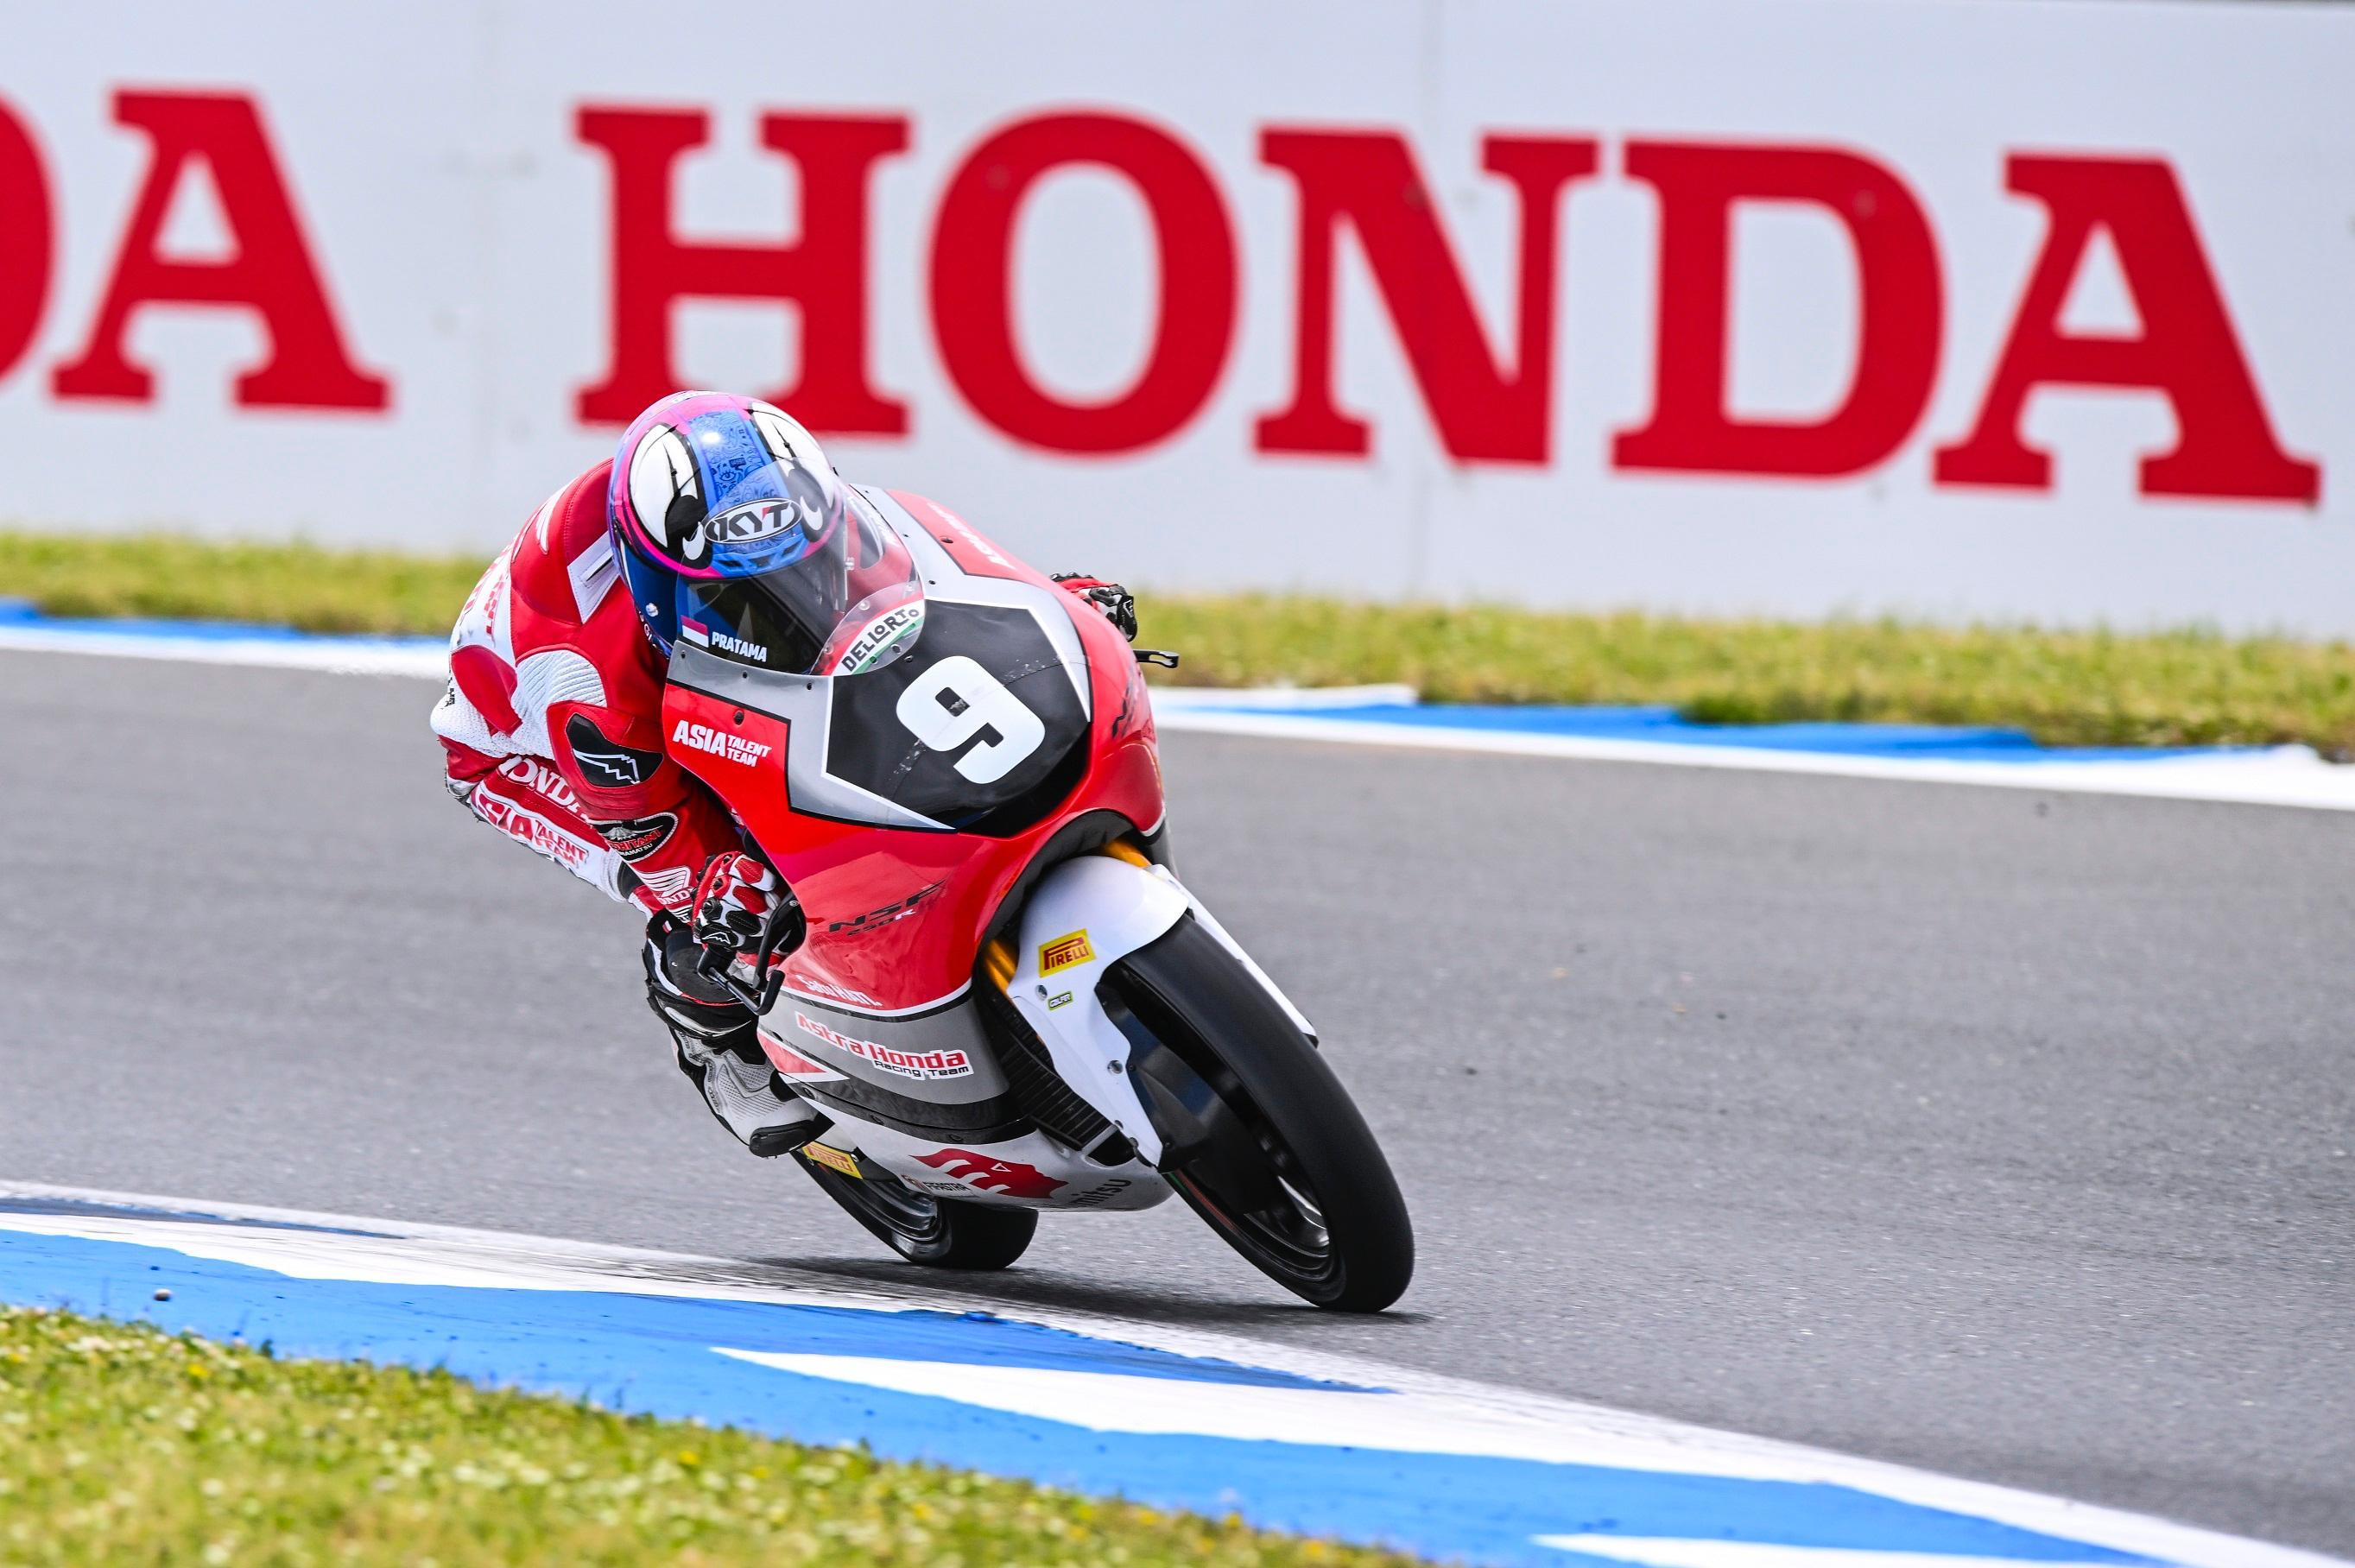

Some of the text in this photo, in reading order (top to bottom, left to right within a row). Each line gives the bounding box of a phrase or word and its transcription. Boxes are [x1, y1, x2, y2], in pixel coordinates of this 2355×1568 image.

[0, 88, 2321, 505] A HONDA
[712, 503, 792, 542] KYT
[712, 631, 768, 662] PRATAMA
[841, 609, 920, 672] DELLORTO
[673, 719, 727, 757] ASIA
[896, 655, 1046, 784] 9
[726, 748, 758, 768] TEAM
[727, 734, 773, 757] TALENT
[535, 819, 587, 862] TALENT
[829, 879, 948, 933] NSF
[1043, 937, 1089, 971] PIRELLI
[796, 1012, 965, 1068] Astra Honda
[875, 1060, 969, 1078] Racing Team
[1068, 1179, 1132, 1207] mitsu
